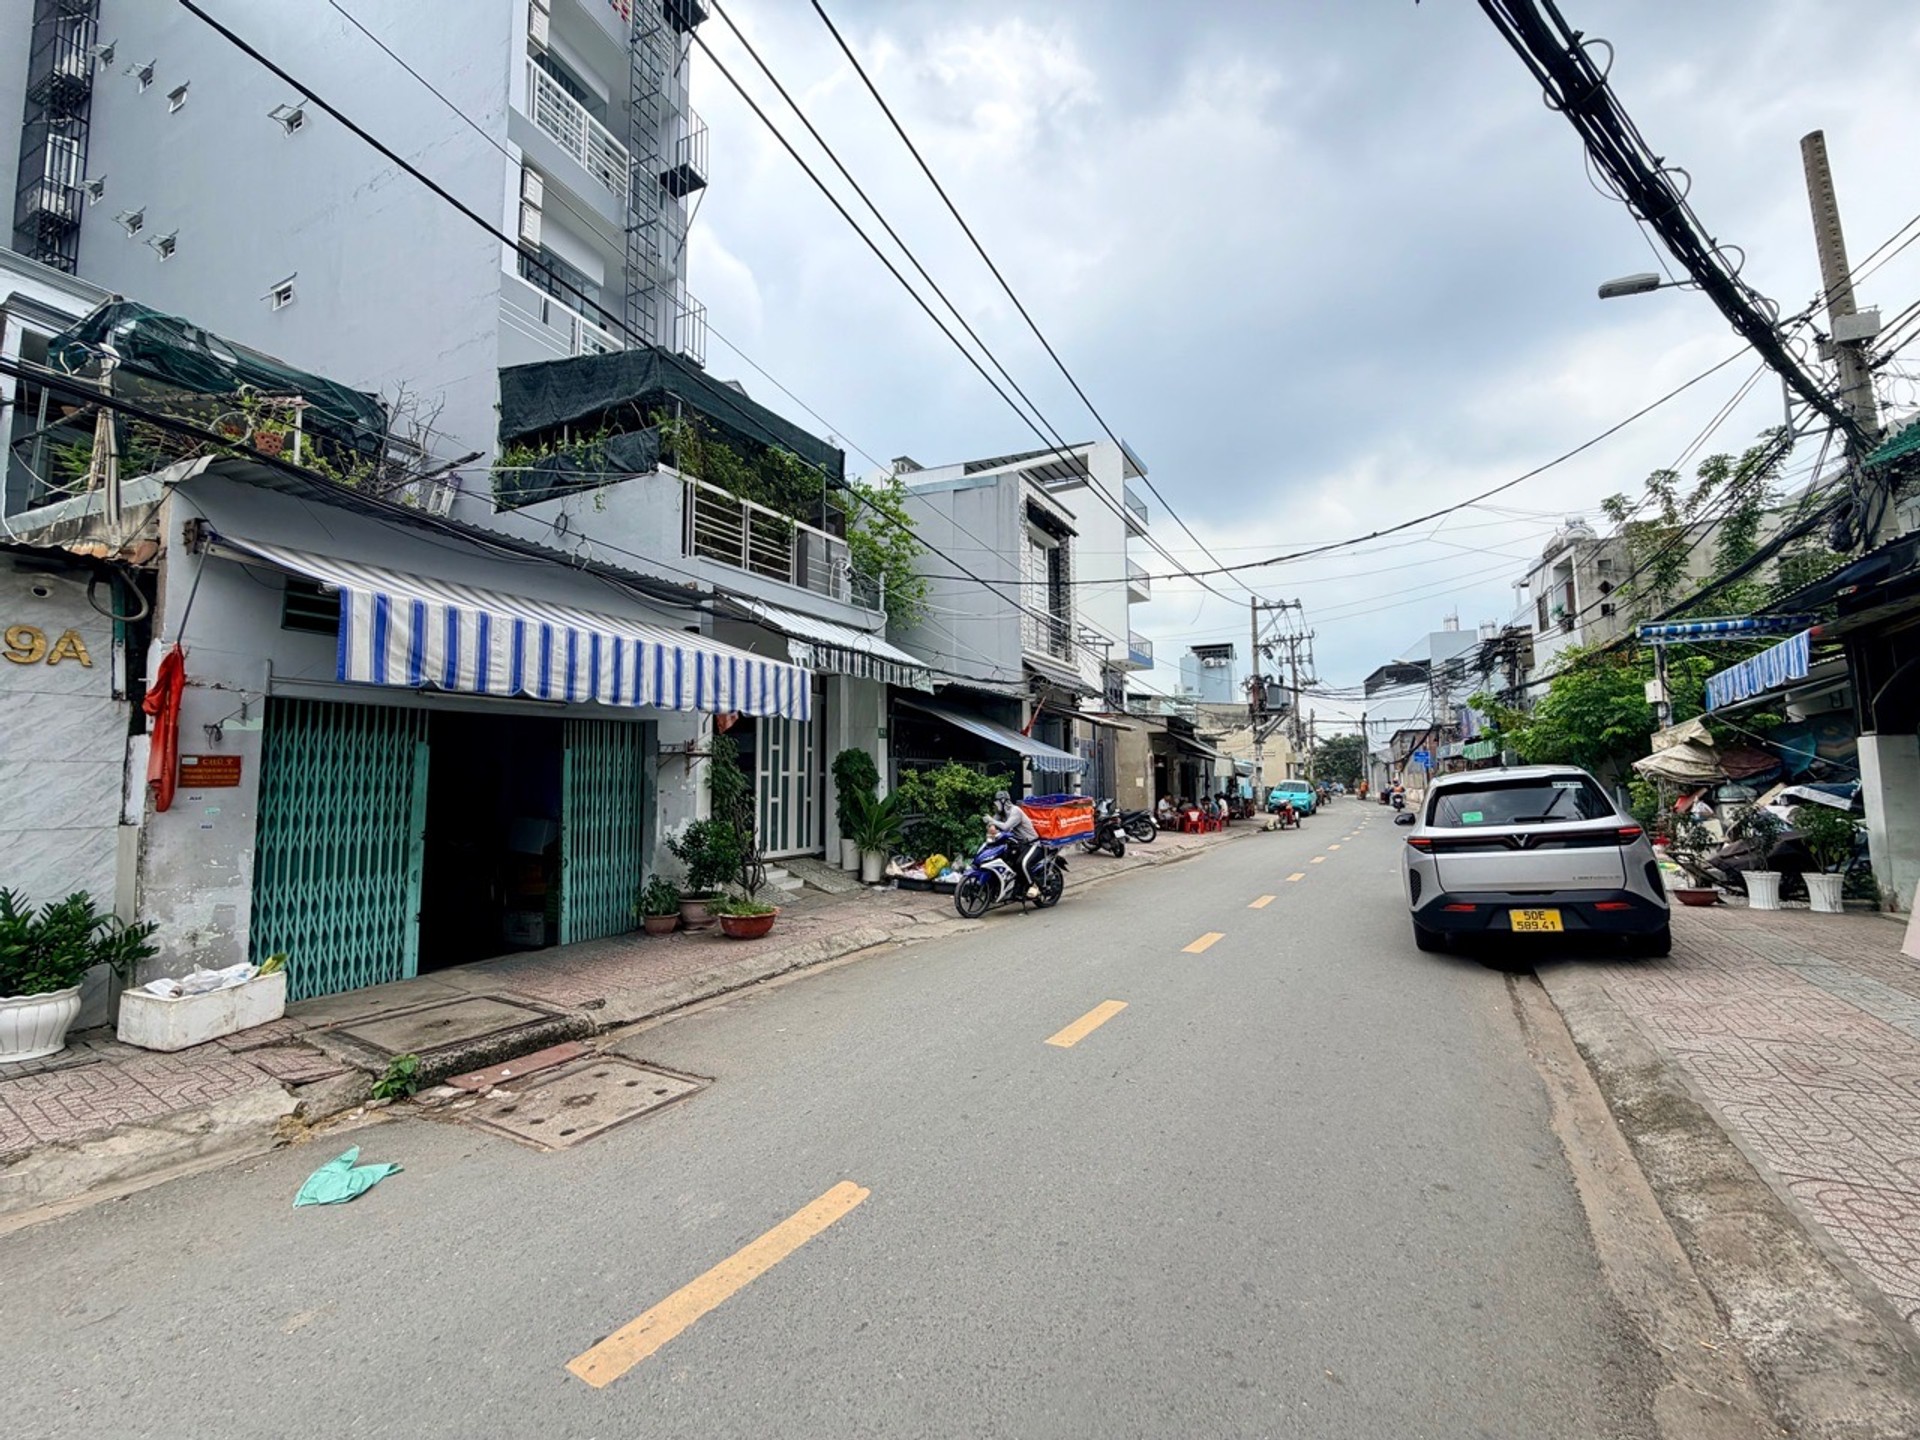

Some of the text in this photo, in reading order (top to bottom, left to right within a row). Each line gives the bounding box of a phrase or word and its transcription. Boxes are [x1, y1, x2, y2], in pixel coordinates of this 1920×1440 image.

[2, 624, 93, 668] 9A
[1523, 910, 1546, 921] 50E
[1516, 920, 1556, 930] 589.41
